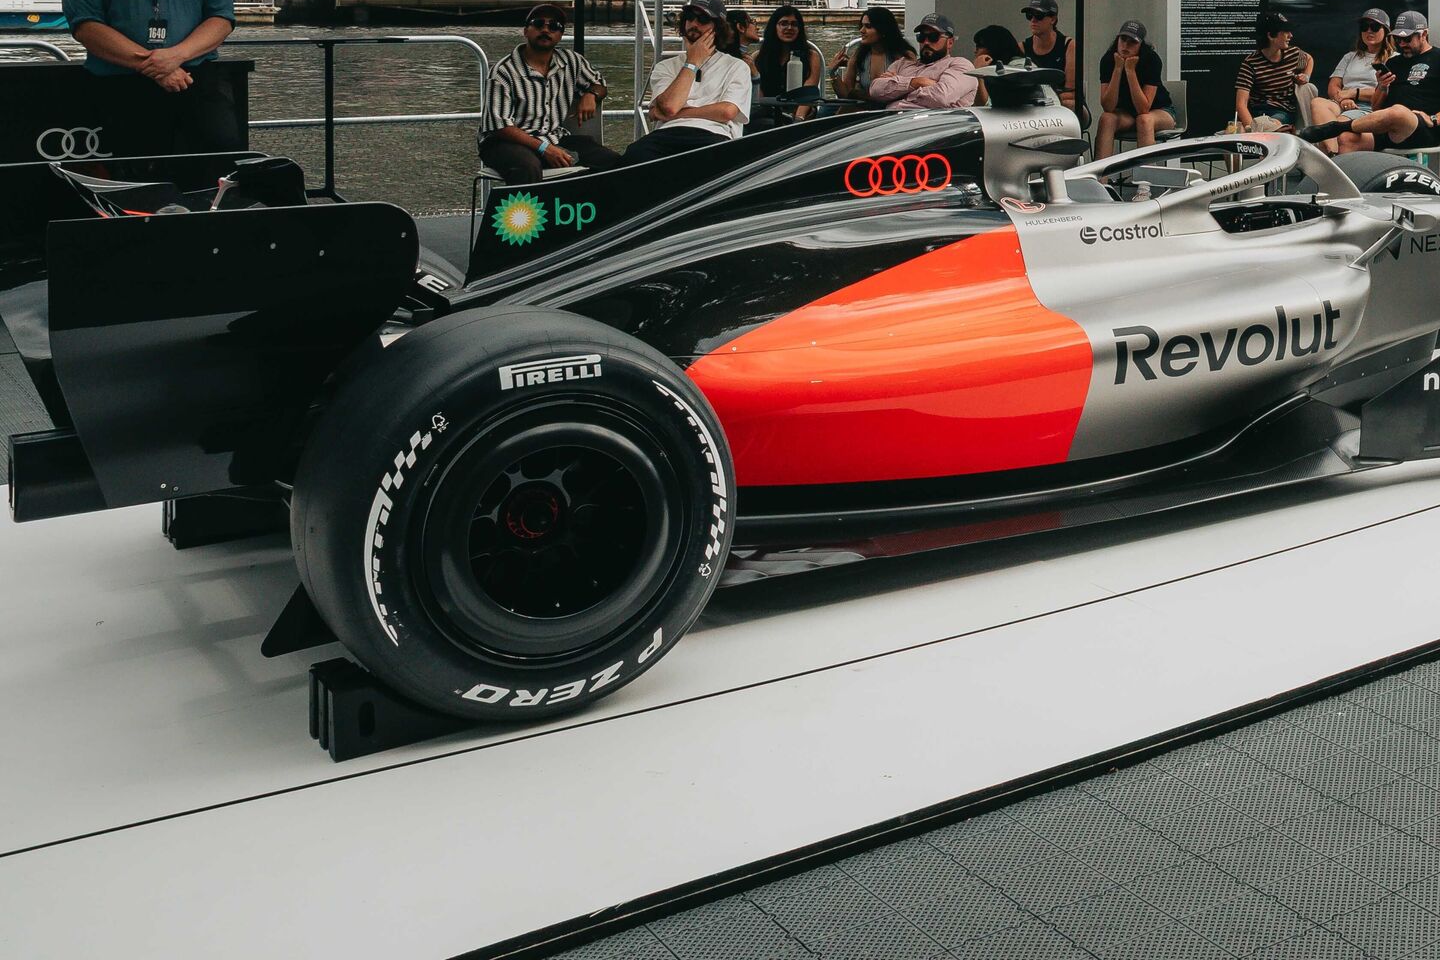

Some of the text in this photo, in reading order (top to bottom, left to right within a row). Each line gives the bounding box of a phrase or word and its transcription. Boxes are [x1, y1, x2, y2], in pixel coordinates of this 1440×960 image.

[148, 27, 167, 39] 1640
[1209, 181, 1240, 196] WORLD
[1386, 173, 1399, 189] P
[555, 197, 596, 231] bp
[1099, 222, 1164, 242] Castrol
[1112, 300, 1341, 385] Revolut
[499, 353, 602, 390] PIRELLI
[461, 626, 663, 707] P ZERO
